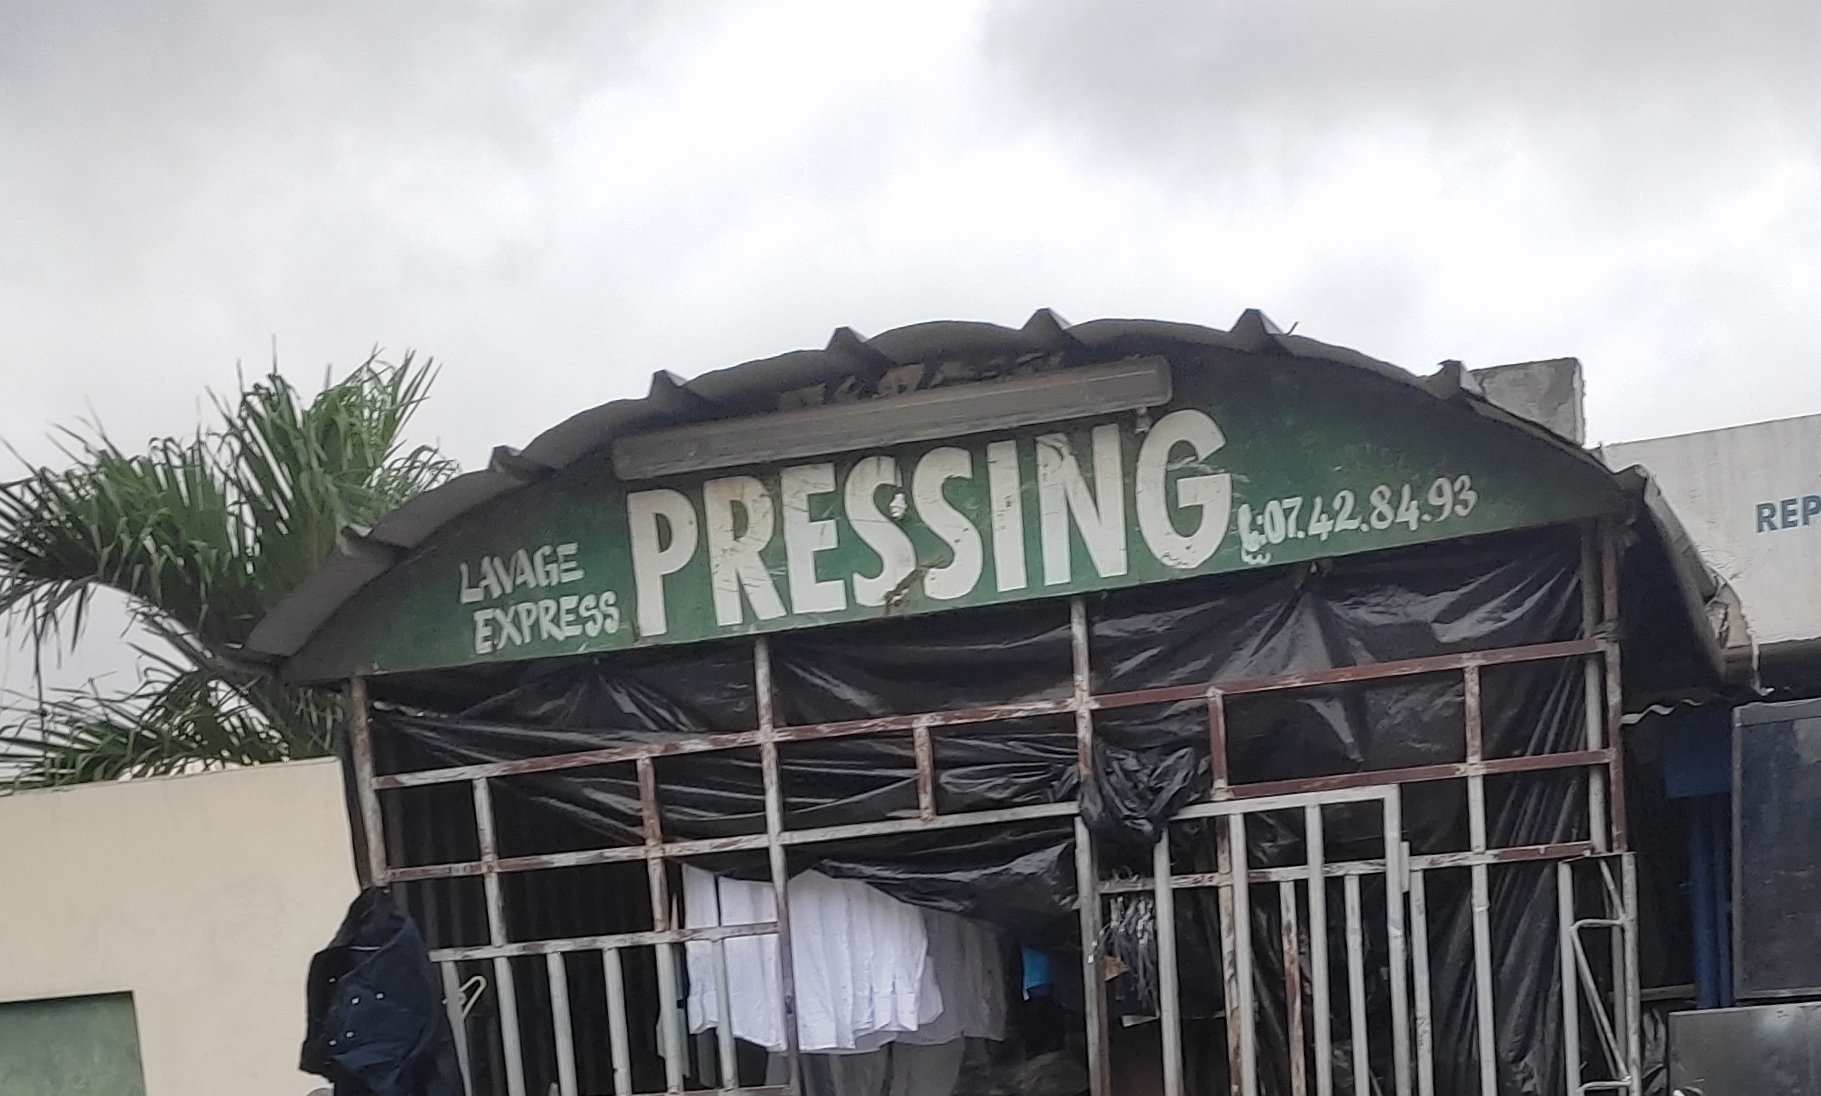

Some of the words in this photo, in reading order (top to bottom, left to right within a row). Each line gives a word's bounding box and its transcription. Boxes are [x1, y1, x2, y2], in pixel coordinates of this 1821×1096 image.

[627, 408, 1232, 638] PRESSING
[459, 541, 585, 604] LAVAGE
[473, 590, 620, 654] EXPRESS
